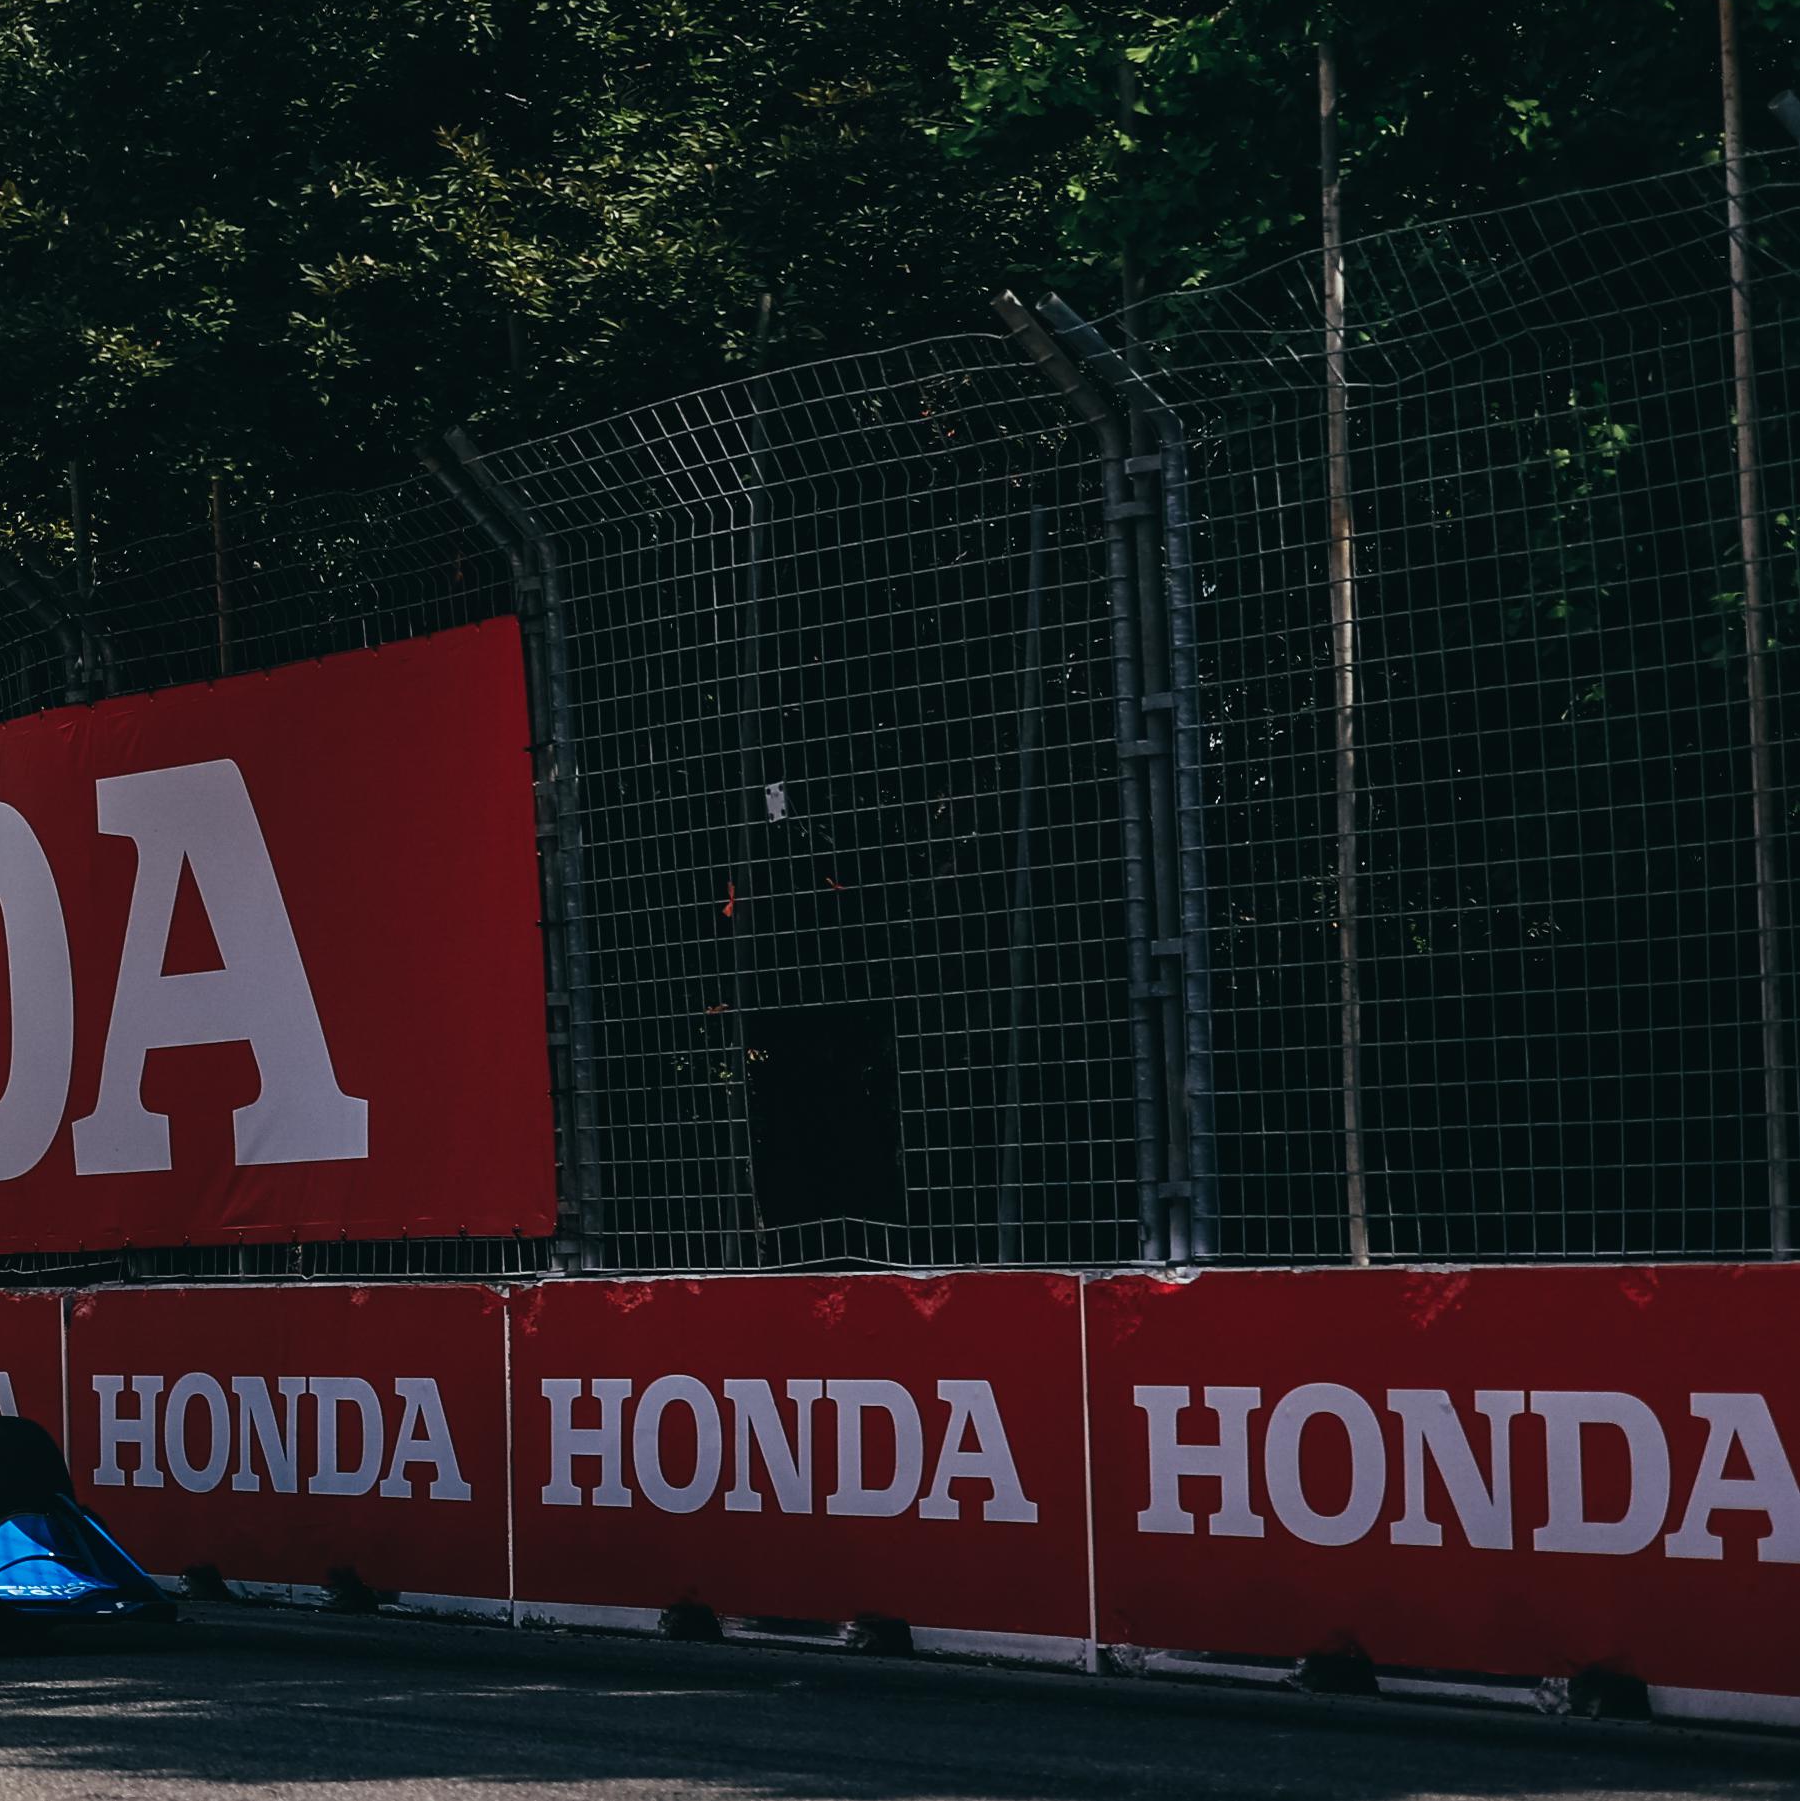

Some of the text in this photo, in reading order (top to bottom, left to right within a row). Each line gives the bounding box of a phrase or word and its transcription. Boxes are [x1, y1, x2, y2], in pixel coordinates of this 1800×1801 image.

[93, 1372, 472, 1501] HONDA
[541, 1374, 1039, 1524] HONDA
[1132, 1382, 1800, 1563] HONDA
